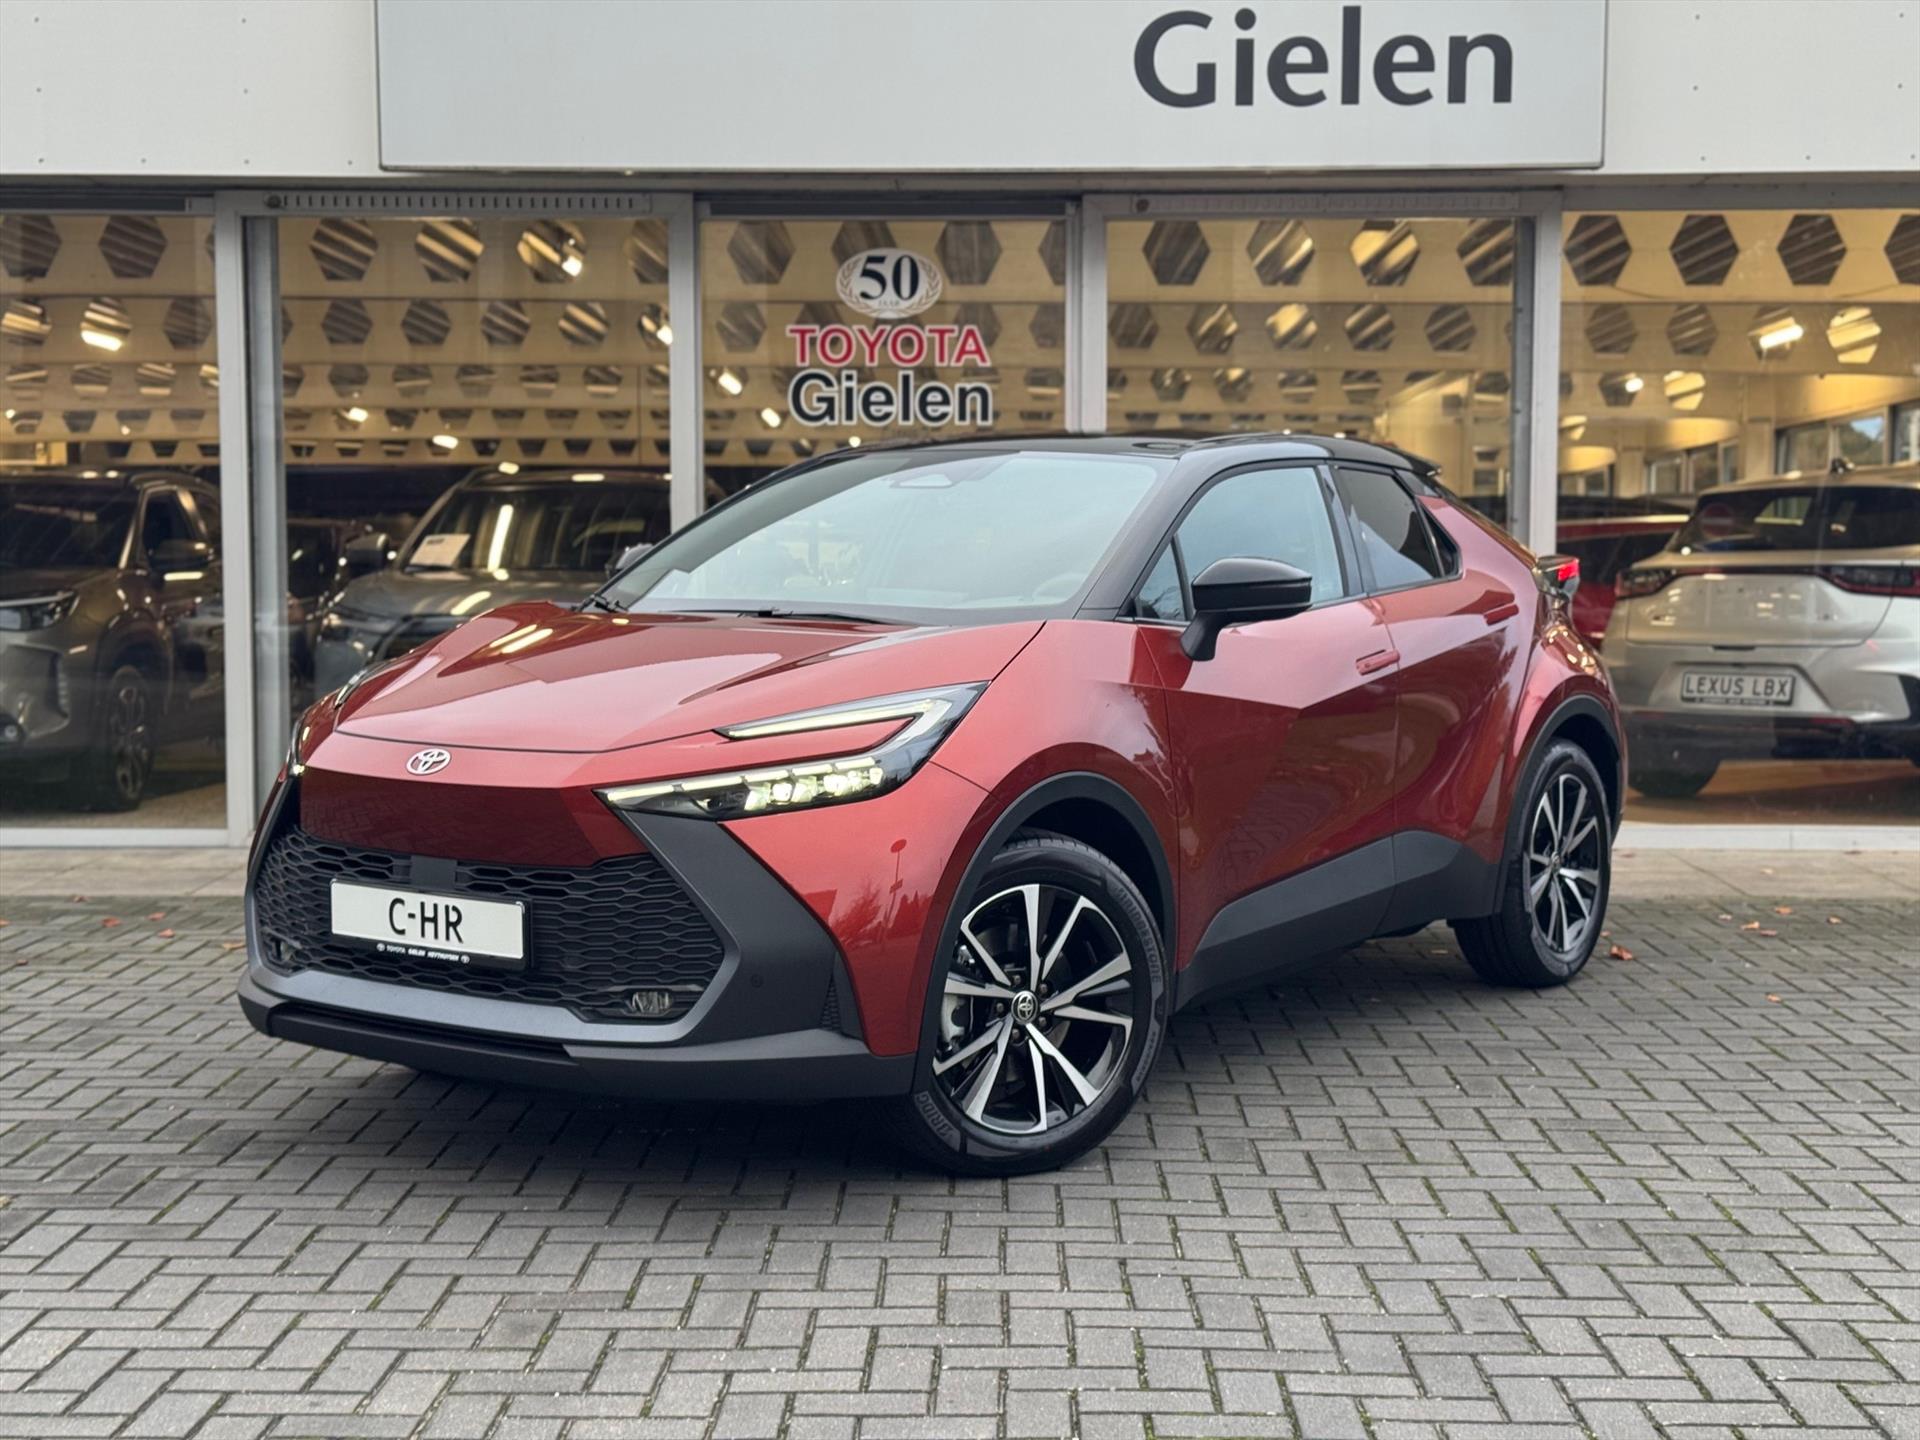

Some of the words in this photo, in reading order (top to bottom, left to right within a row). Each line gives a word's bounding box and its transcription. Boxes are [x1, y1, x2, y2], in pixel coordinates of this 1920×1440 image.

[1134, 5, 1513, 108] Gielen
[859, 254, 920, 301] 50
[787, 326, 990, 366] TOYOTA
[789, 370, 992, 425] Gielen
[1685, 676, 1745, 695] LEXUS
[1752, 678, 1789, 697] LBX
[389, 897, 463, 944] C-HR
